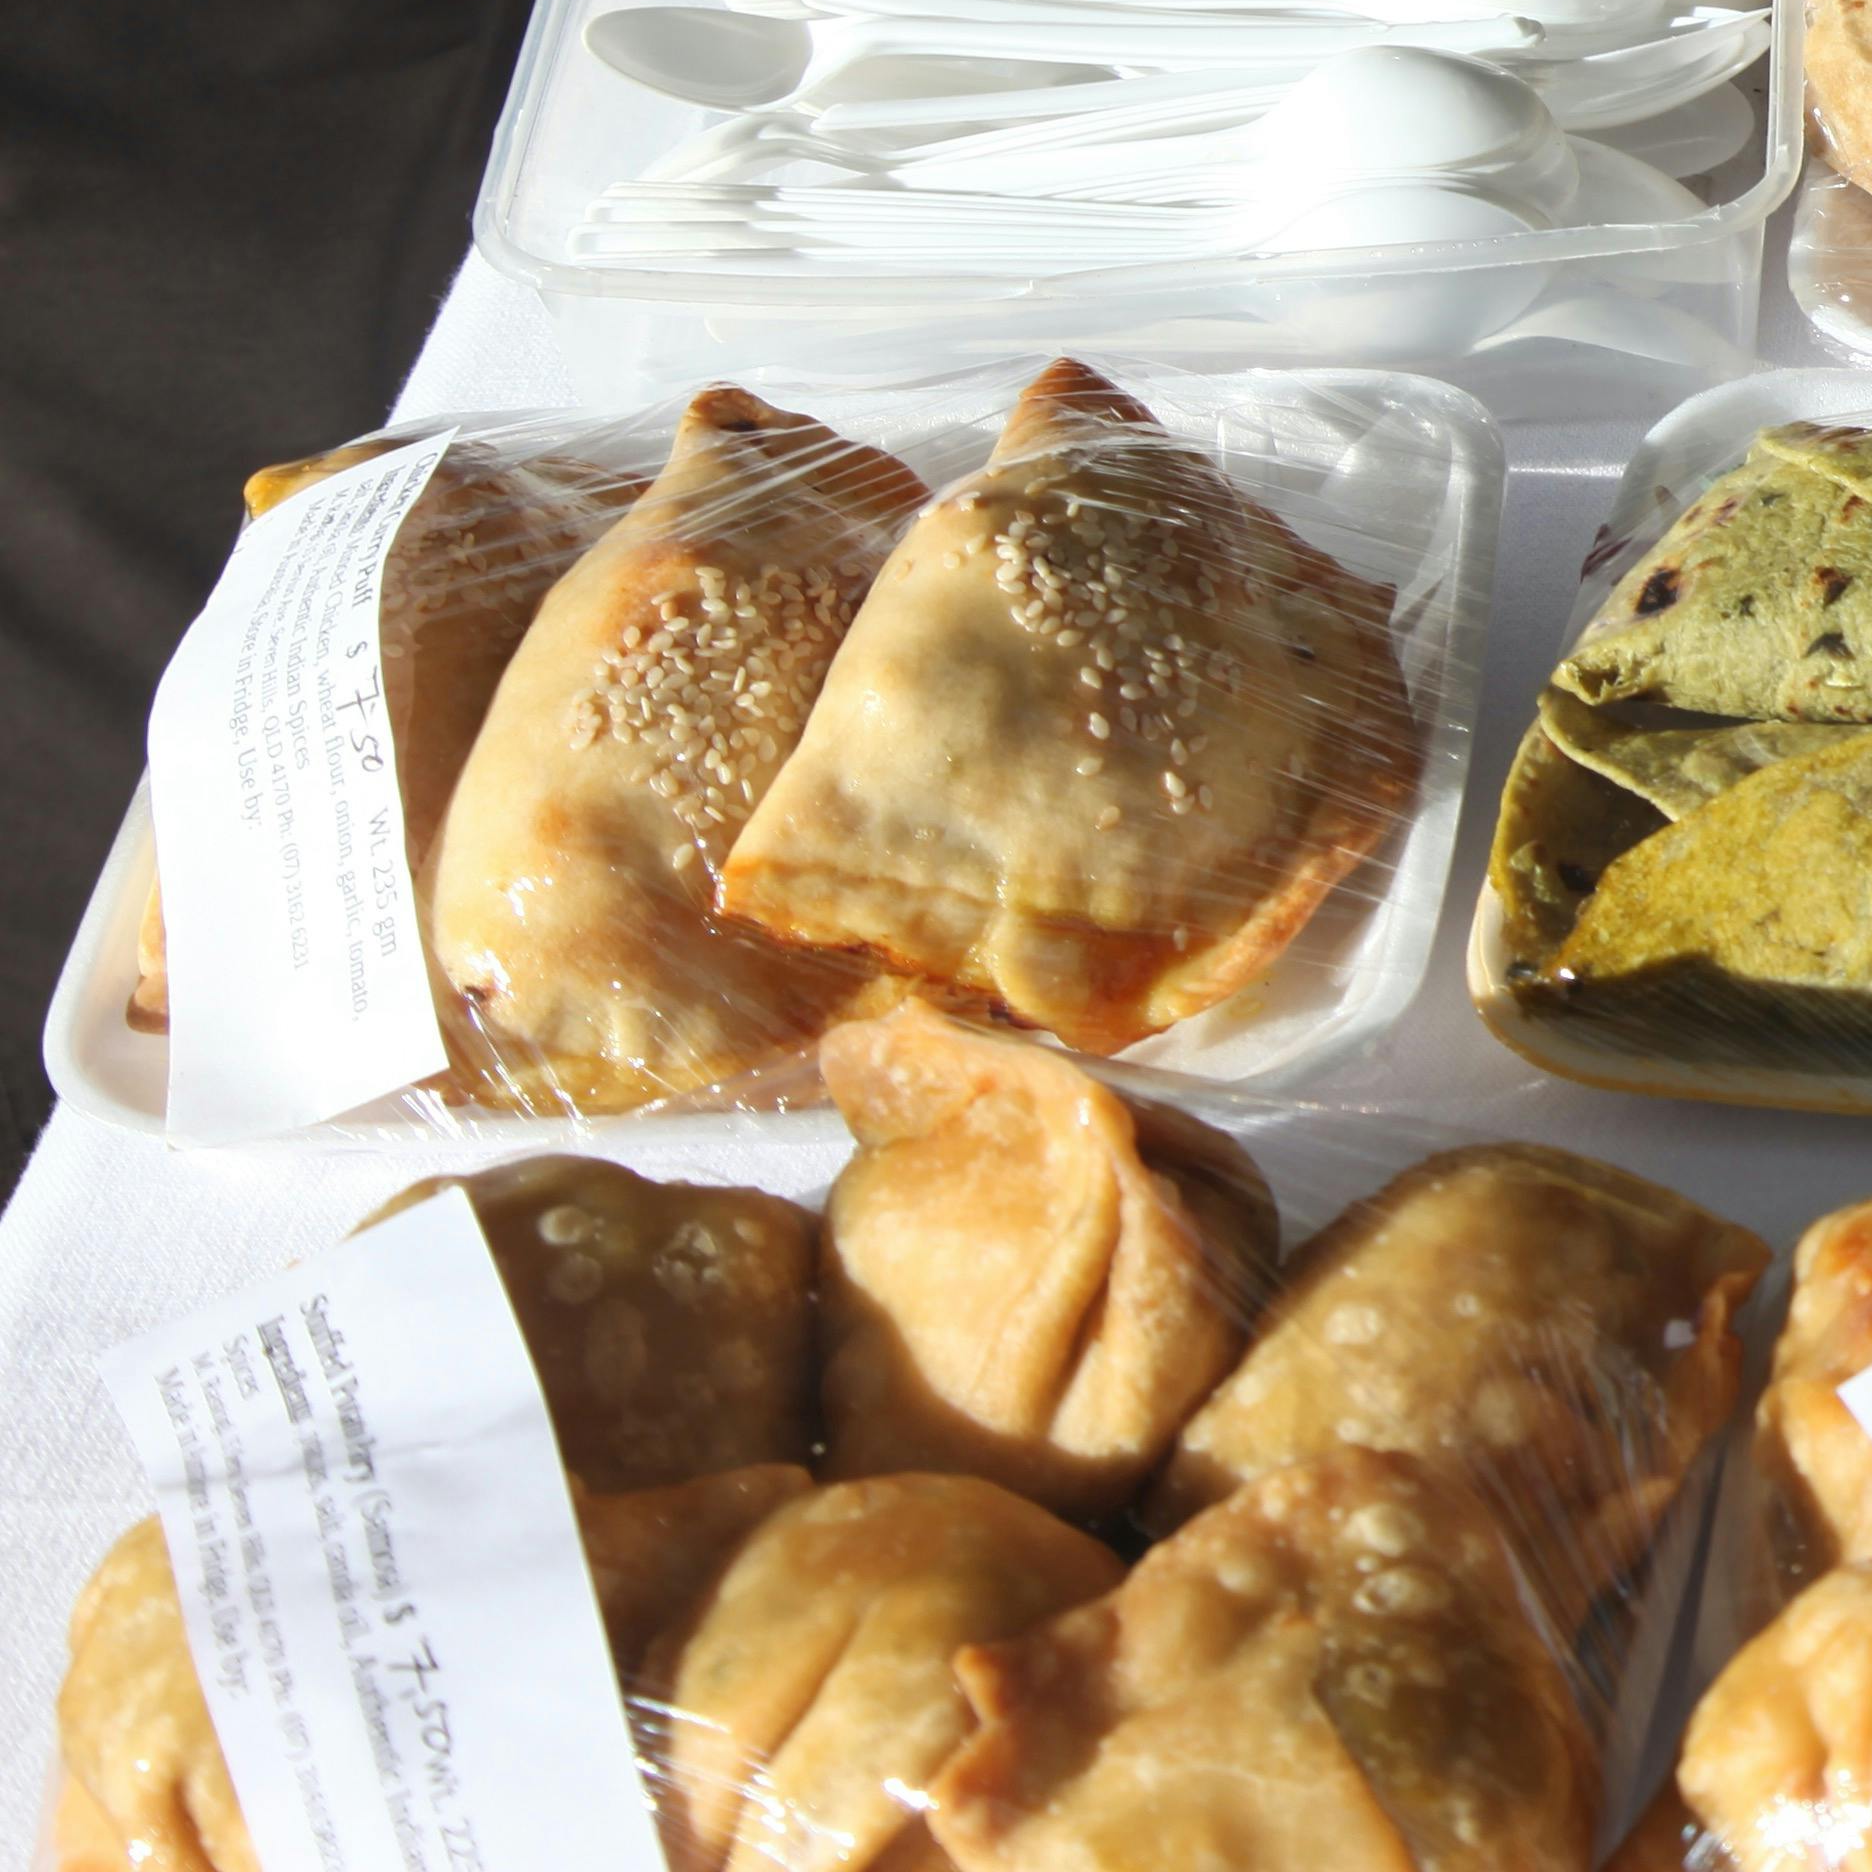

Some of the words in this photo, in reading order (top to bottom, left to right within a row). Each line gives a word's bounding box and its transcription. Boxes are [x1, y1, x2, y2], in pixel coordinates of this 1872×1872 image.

[351, 560, 377, 607] Puff
[286, 635, 308, 696] Indian
[230, 673, 253, 745] Fridge,
[316, 668, 339, 731] wheat
[260, 714, 283, 759] QLD
[284, 699, 309, 770] Spices
[237, 747, 257, 789] Use
[270, 763, 291, 806] 4170
[323, 734, 345, 795] flour,
[334, 799, 352, 867] onion,
[368, 806, 391, 856] Wt.
[371, 915, 397, 957] gm
